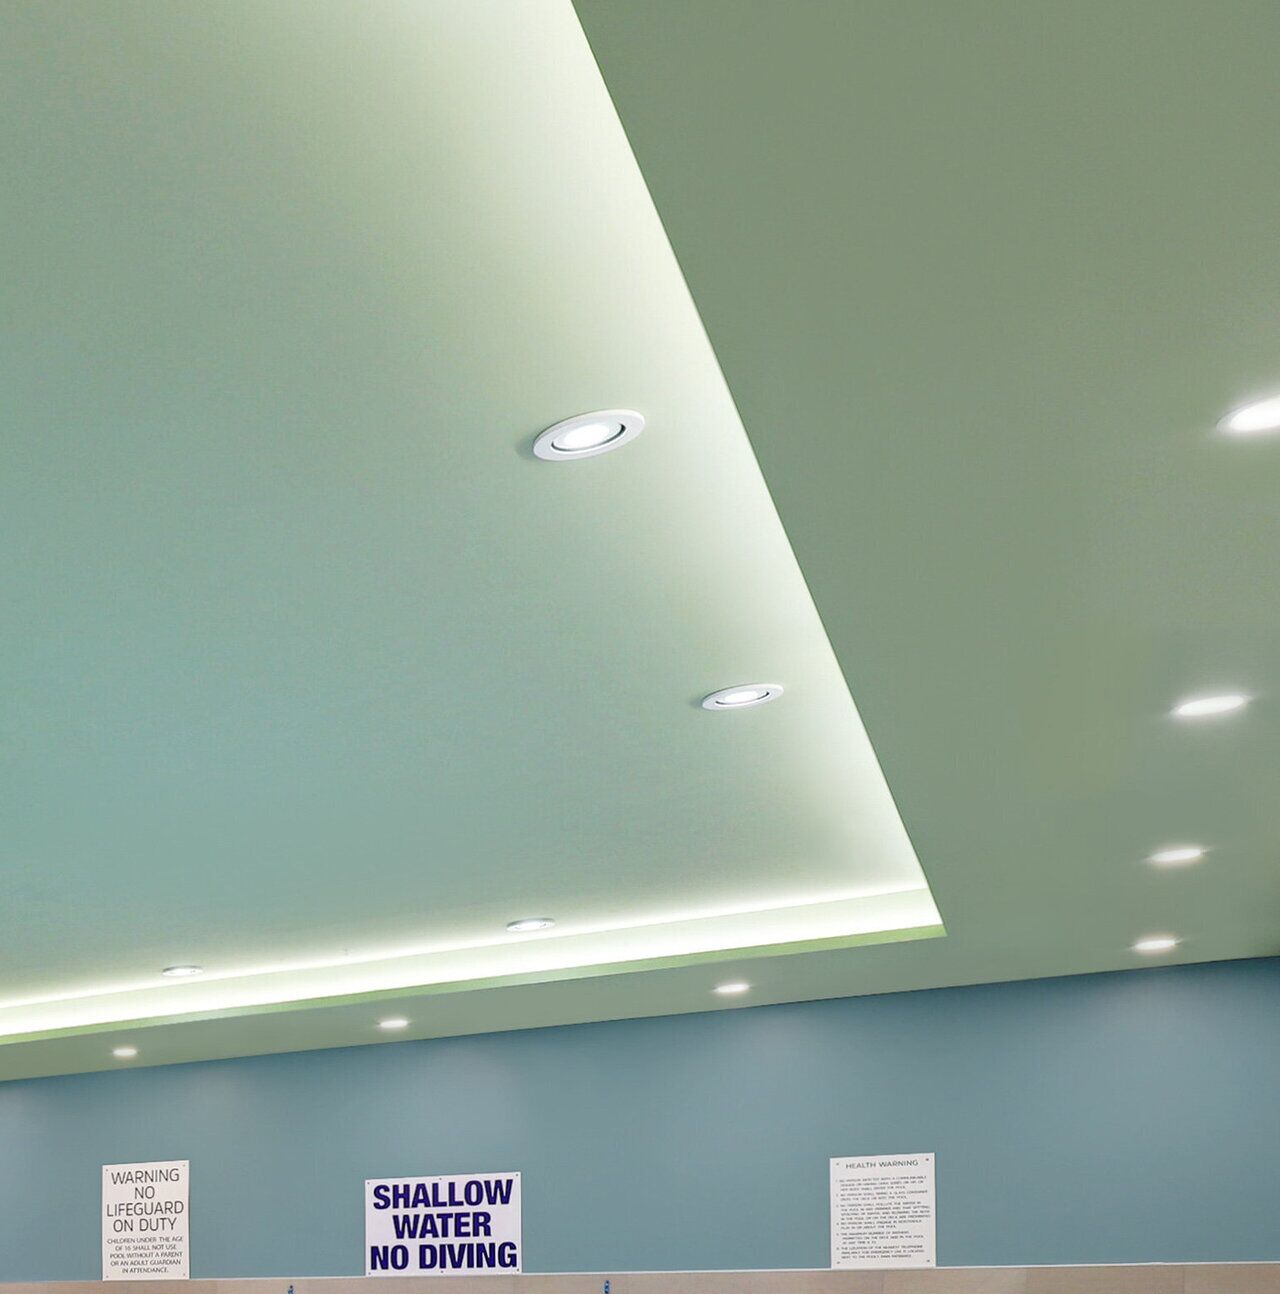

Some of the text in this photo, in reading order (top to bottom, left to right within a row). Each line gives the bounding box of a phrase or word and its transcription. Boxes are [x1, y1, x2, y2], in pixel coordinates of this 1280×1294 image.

[111, 1168, 179, 1185] WARNING
[134, 1185, 154, 1200] NO
[374, 1179, 513, 1209] SHALLOW
[106, 1200, 183, 1217] LIFEGUARD
[113, 1217, 176, 1232] ON DUTY
[393, 1212, 491, 1239] WATER
[371, 1242, 517, 1270] NO DIVING
